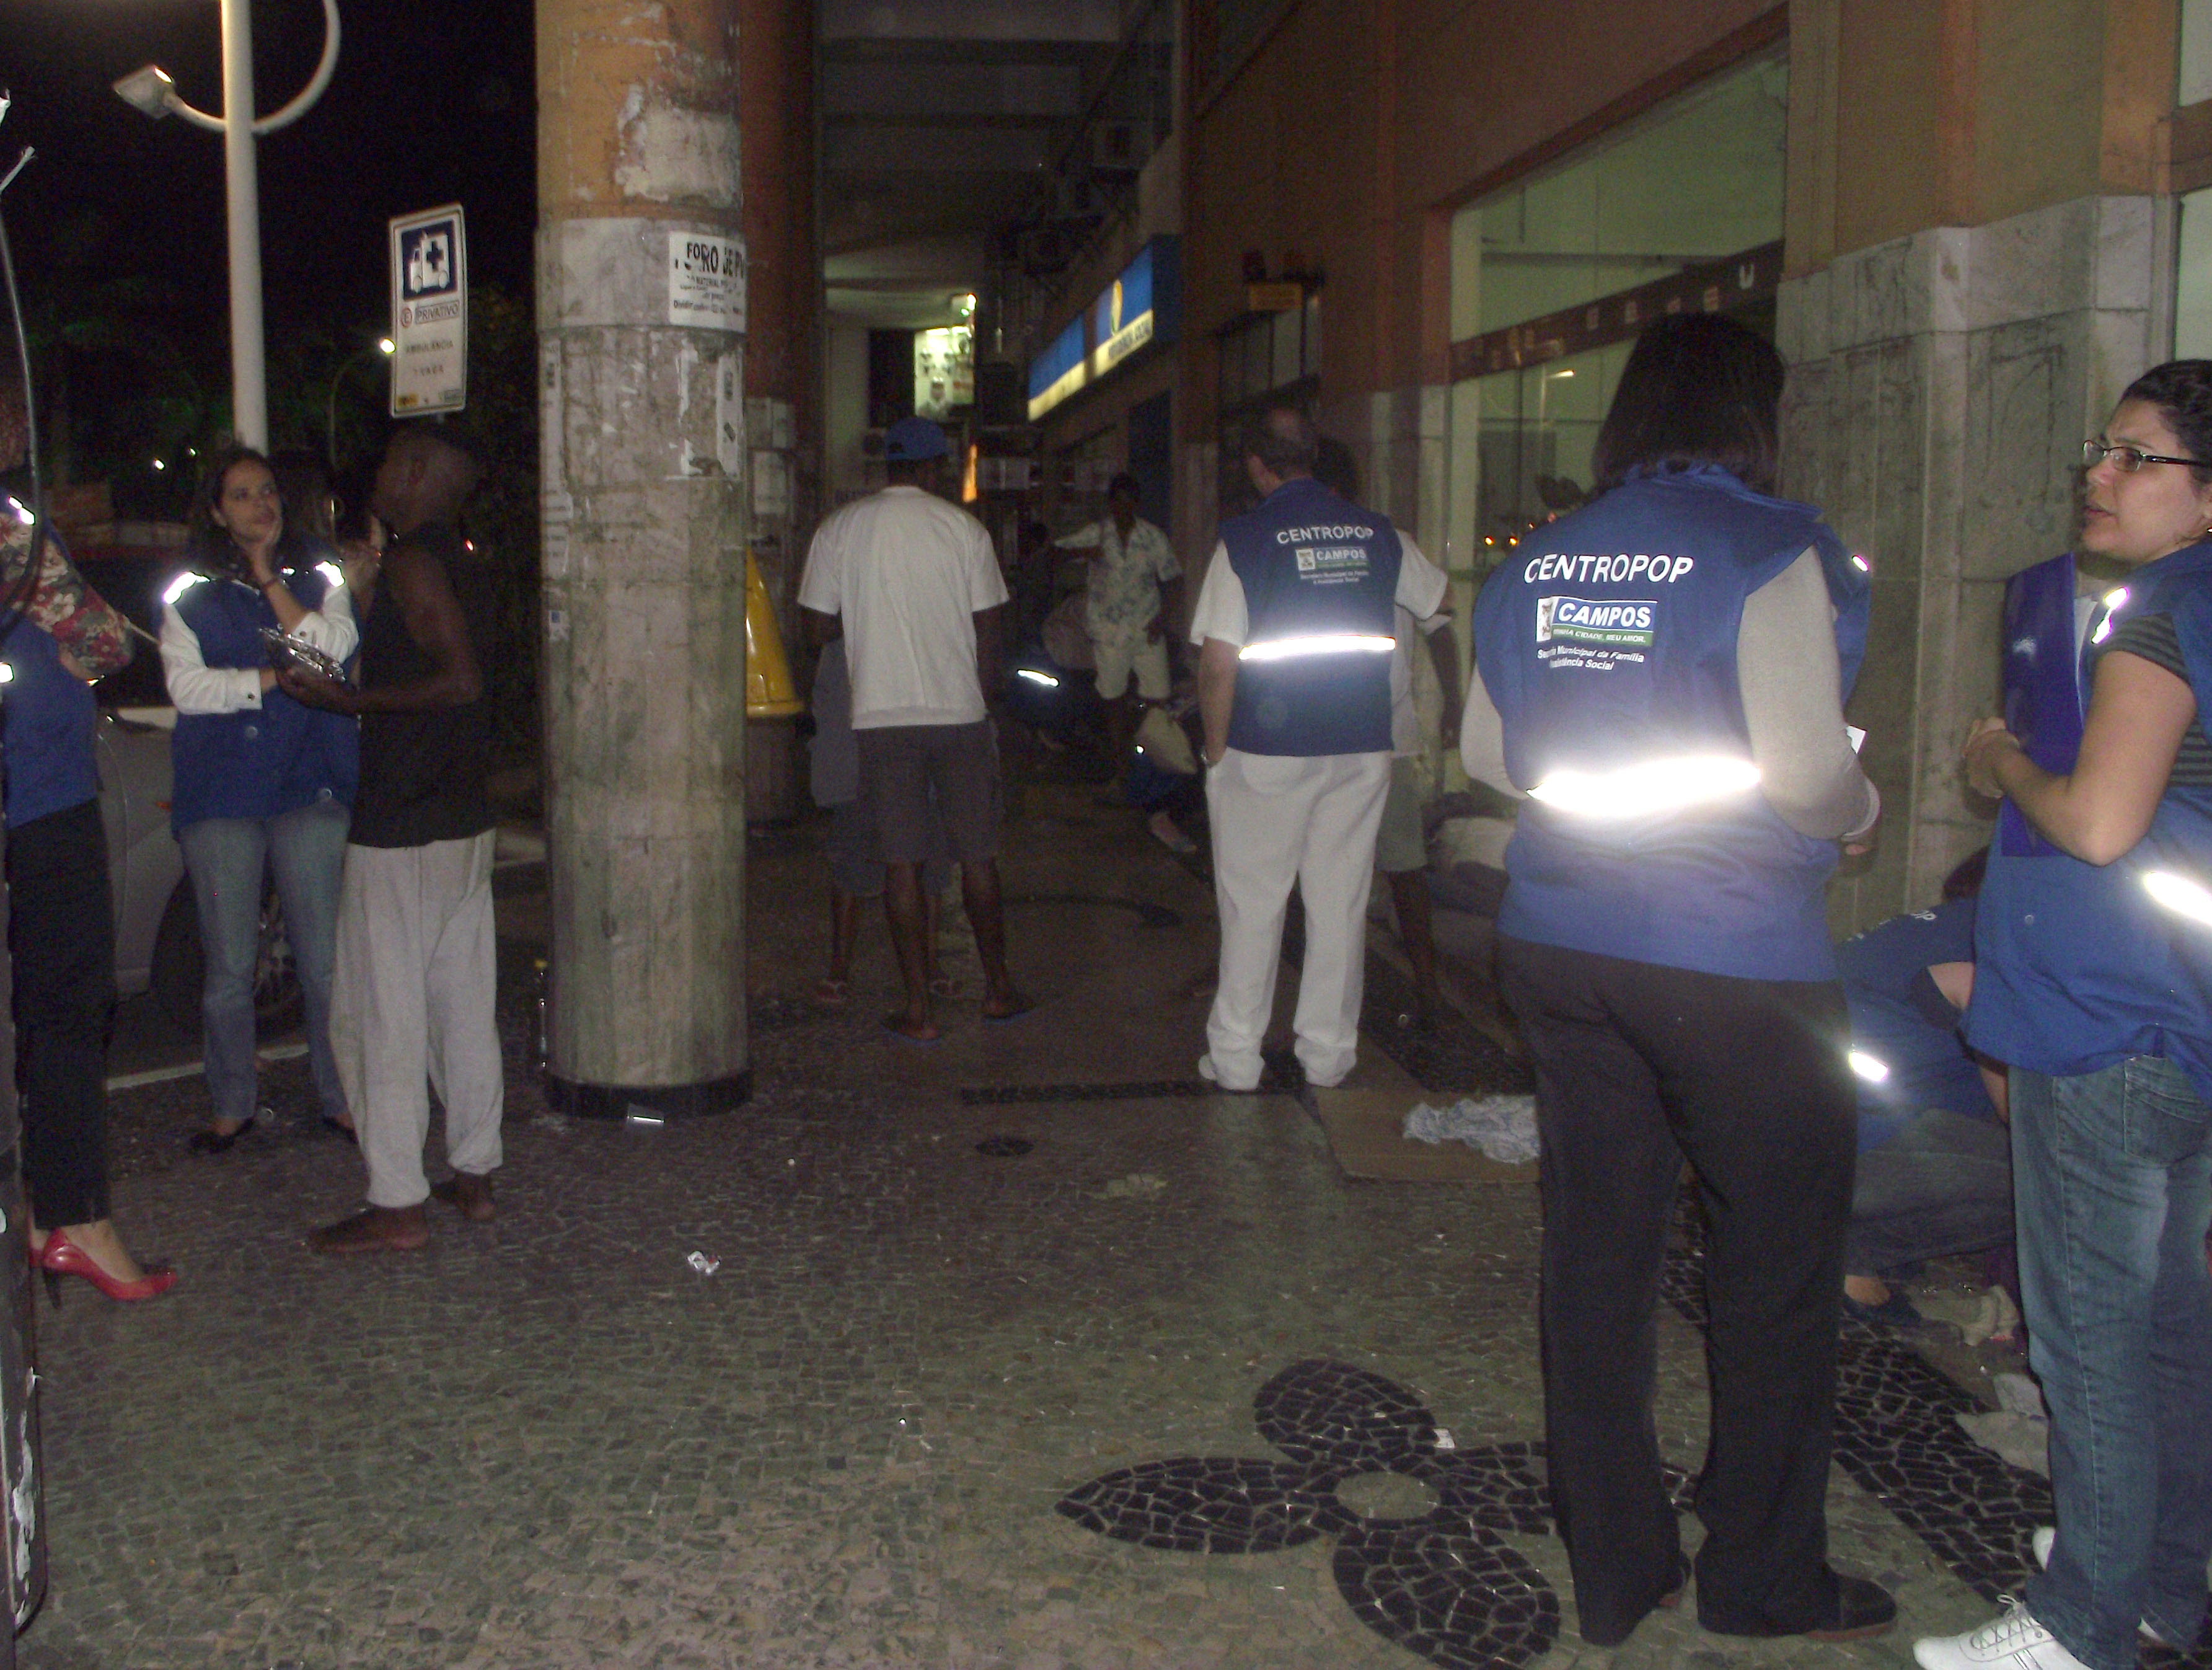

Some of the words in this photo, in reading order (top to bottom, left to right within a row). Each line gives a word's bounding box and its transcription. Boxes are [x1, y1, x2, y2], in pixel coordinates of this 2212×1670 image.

[418, 304, 459, 320] PRIVATIVO
[1276, 526, 1375, 544] CENTROPOP
[1316, 549, 1367, 561] CAMPOS
[1523, 554, 1694, 584] CENTROPOP
[1558, 602, 1651, 628] CAMPOS
[1556, 645, 1597, 657] Municipal
[1585, 659, 1615, 670] Social
